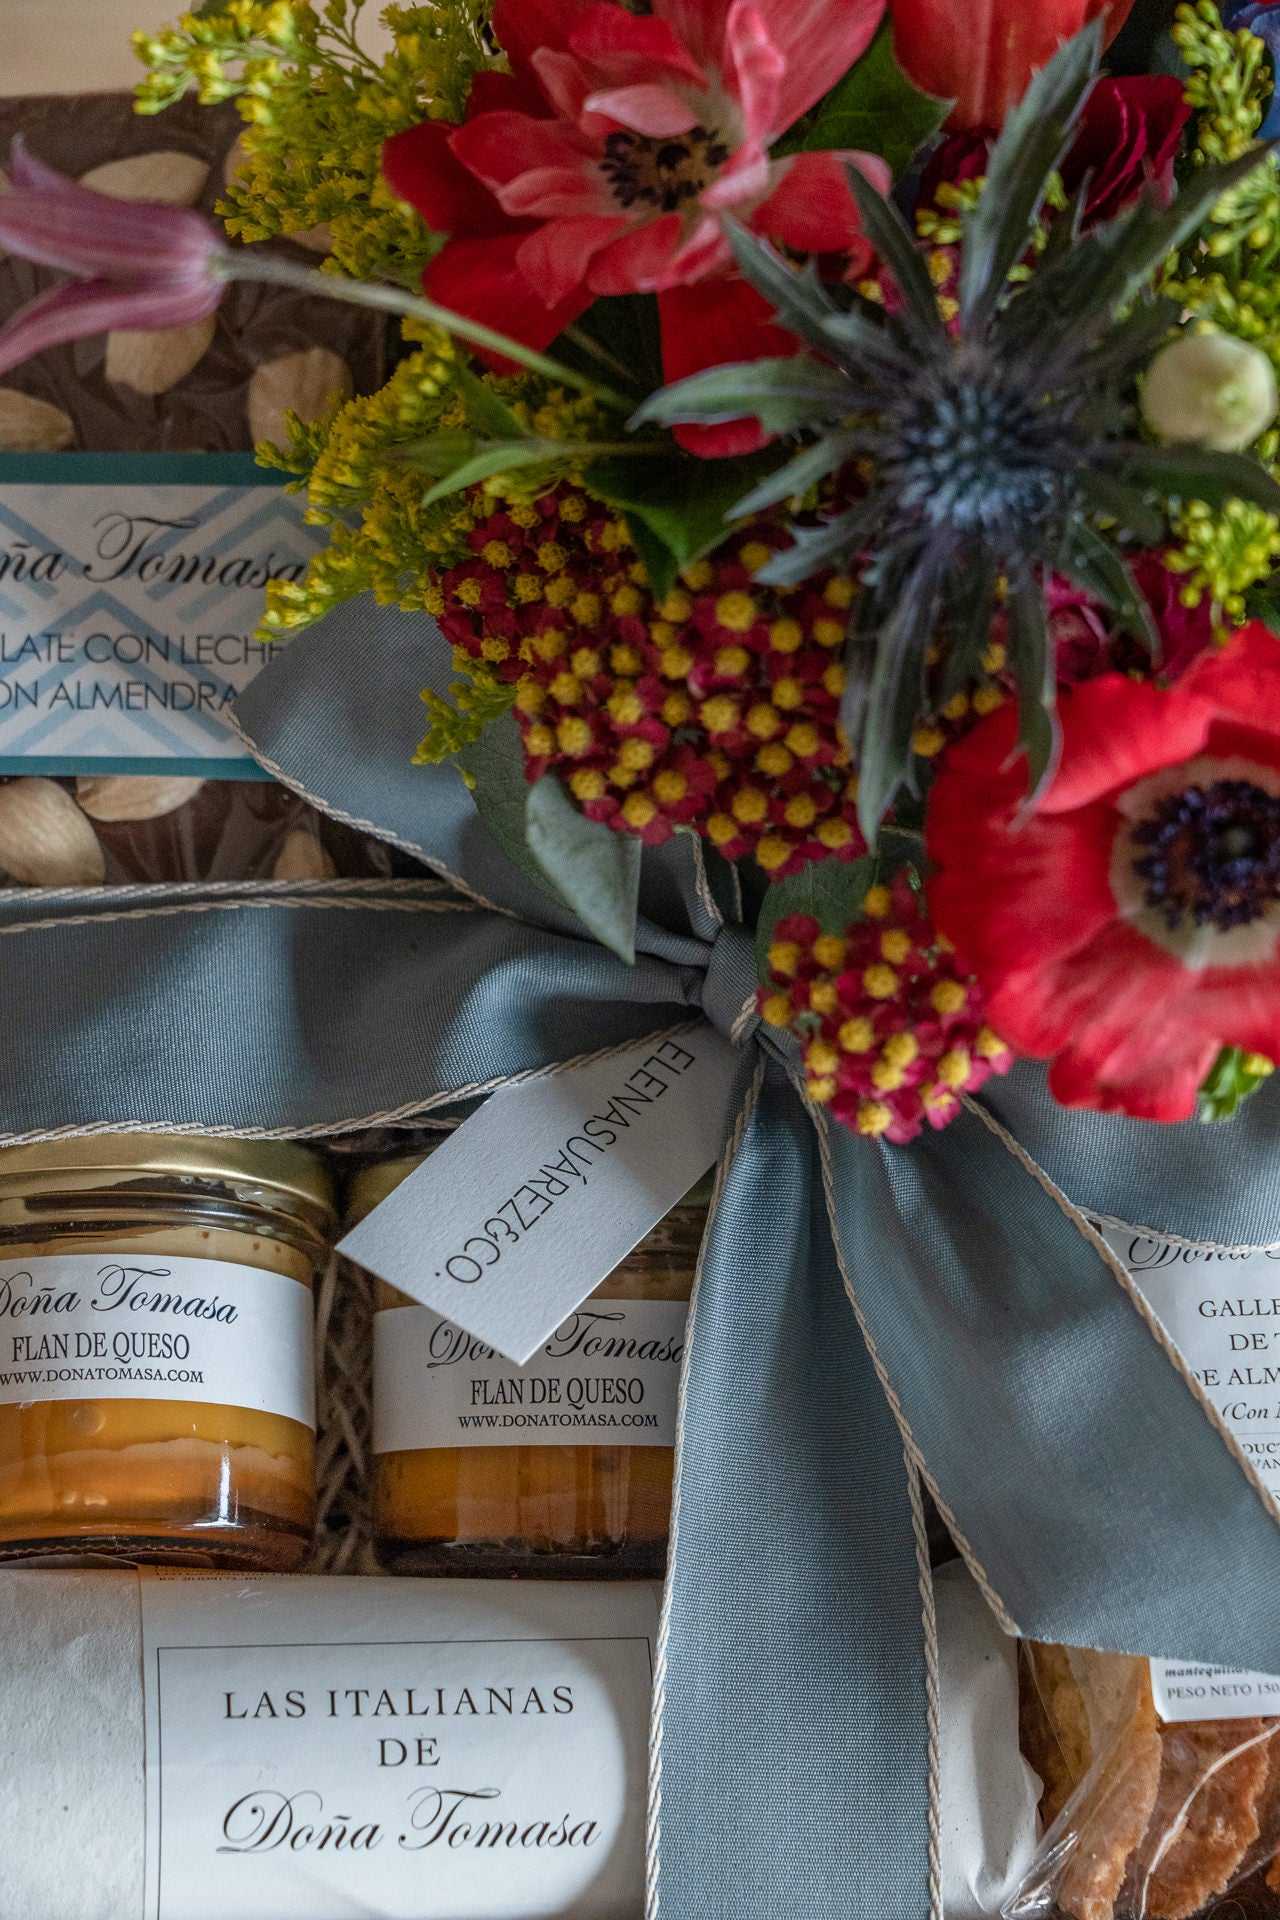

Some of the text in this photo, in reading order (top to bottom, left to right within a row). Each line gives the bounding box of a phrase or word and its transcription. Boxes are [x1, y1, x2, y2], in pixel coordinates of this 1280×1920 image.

[84, 513, 306, 589] Tomasa
[1, 632, 75, 663] LATE
[84, 633, 170, 665] CON
[90, 1264, 239, 1325] Tomasa
[11, 1332, 190, 1364] FLAN DE QUESO
[1229, 1333, 1269, 1351] DE
[0, 1367, 204, 1386] WWW.DONATOMASA.COM
[470, 1377, 645, 1411] FLAN DE QUESO
[458, 1413, 659, 1428] WWW.DONATOMASA.COM
[1222, 1401, 1268, 1420] (Con
[222, 1685, 576, 1720] LAS ITALIANAS
[1167, 1686, 1206, 1699] PESO
[1210, 1683, 1252, 1697] NETO
[376, 1736, 442, 1768] DE
[215, 1785, 602, 1855] Doña Tomasa
